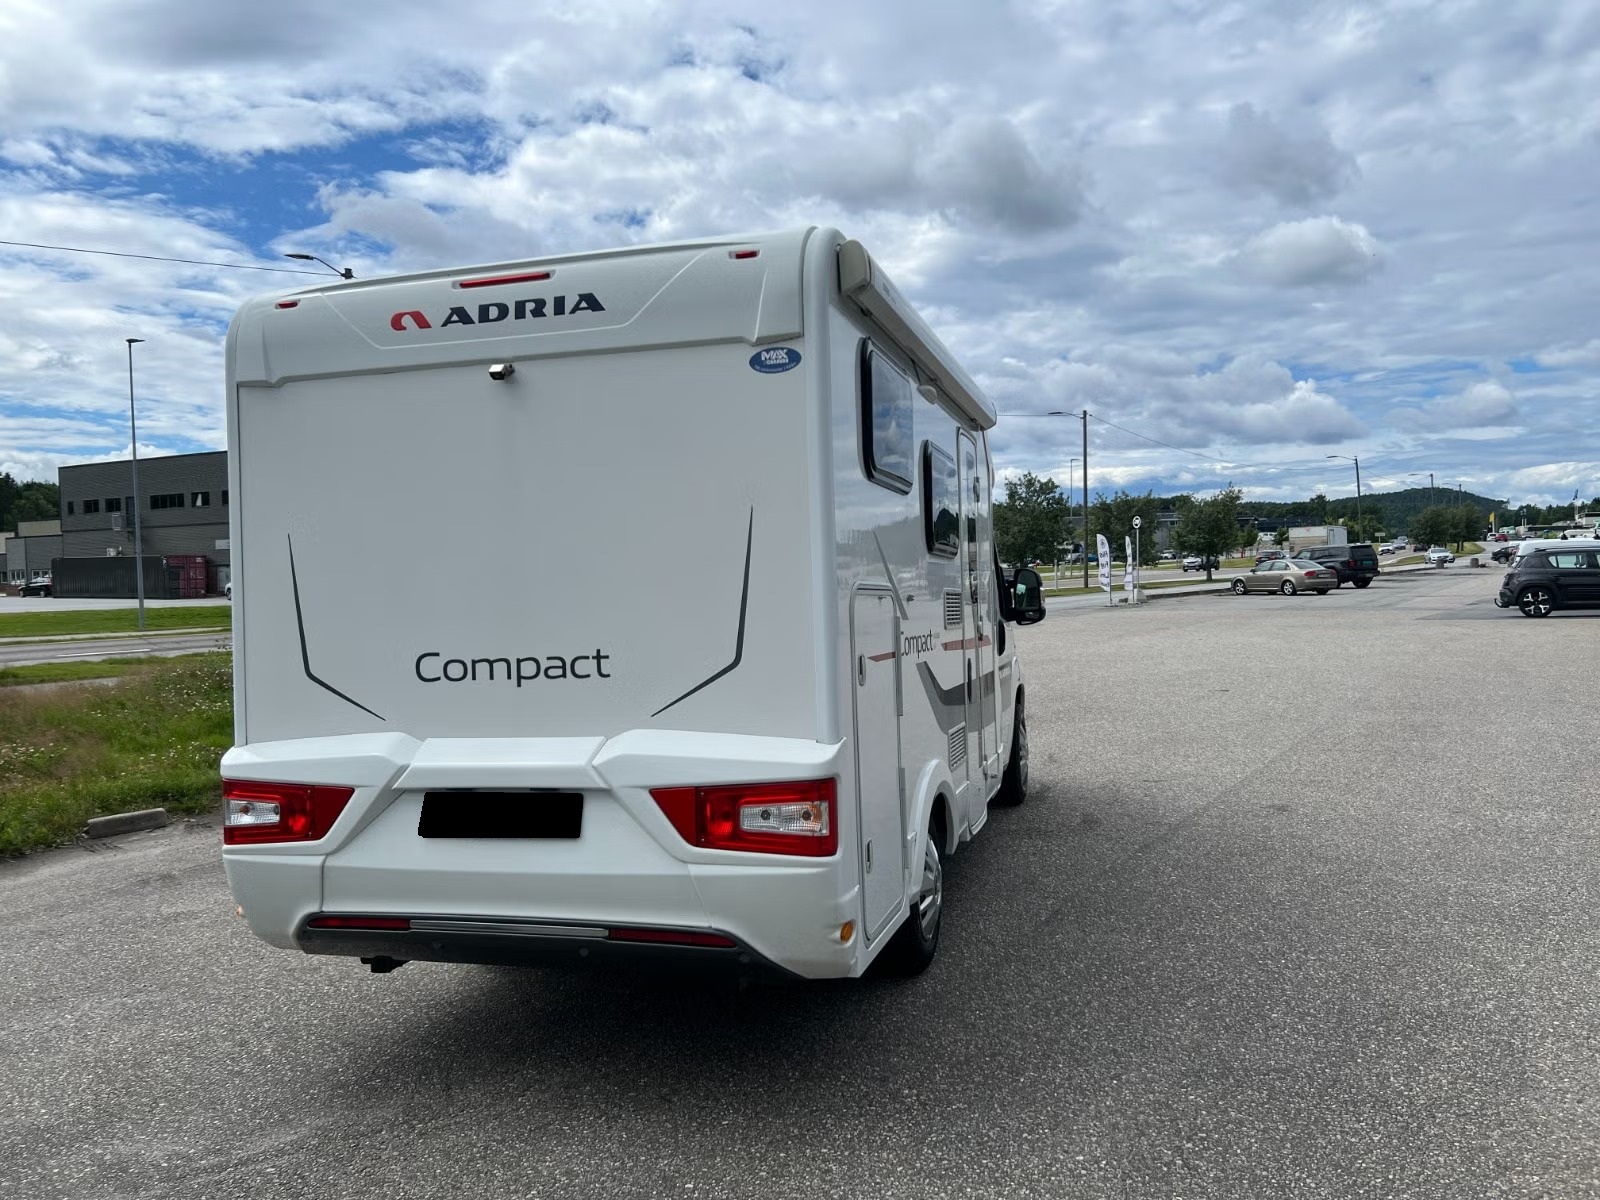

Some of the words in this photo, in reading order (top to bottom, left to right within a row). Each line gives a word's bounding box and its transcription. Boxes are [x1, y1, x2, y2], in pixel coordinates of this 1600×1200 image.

[440, 292, 606, 328] ADRIA
[761, 349, 788, 361] MAX
[415, 648, 611, 688] Compact
